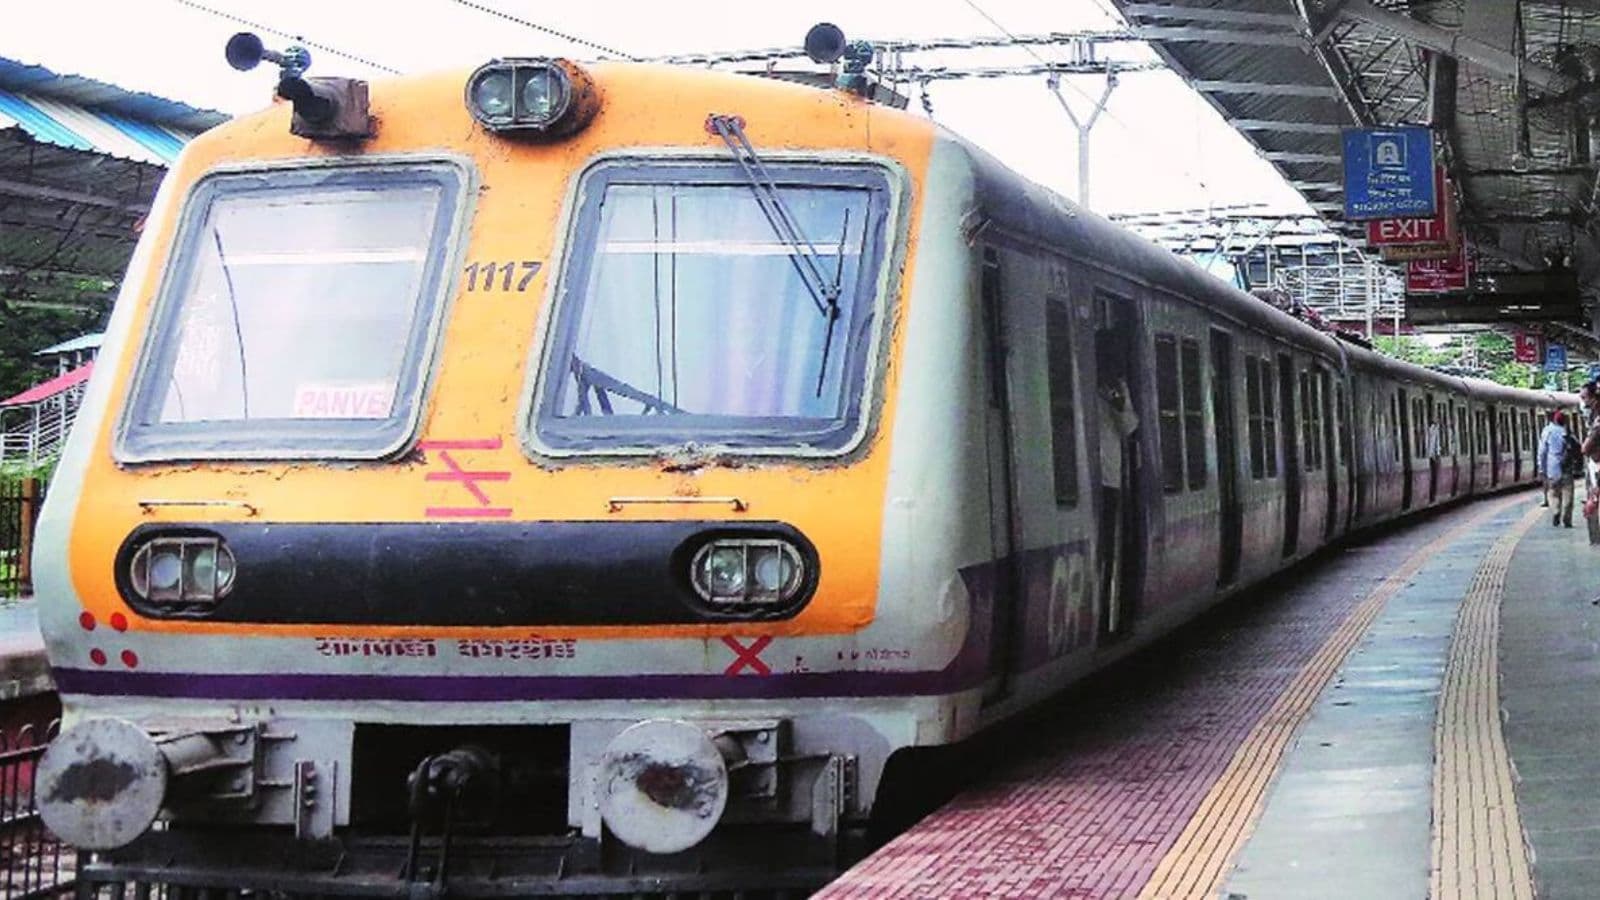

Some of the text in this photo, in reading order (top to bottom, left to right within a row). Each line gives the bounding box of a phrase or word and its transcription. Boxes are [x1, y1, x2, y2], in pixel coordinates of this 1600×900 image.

[1380, 219, 1435, 238] EXIT
[464, 261, 543, 292] 1117
[297, 391, 388, 415] PANVE
